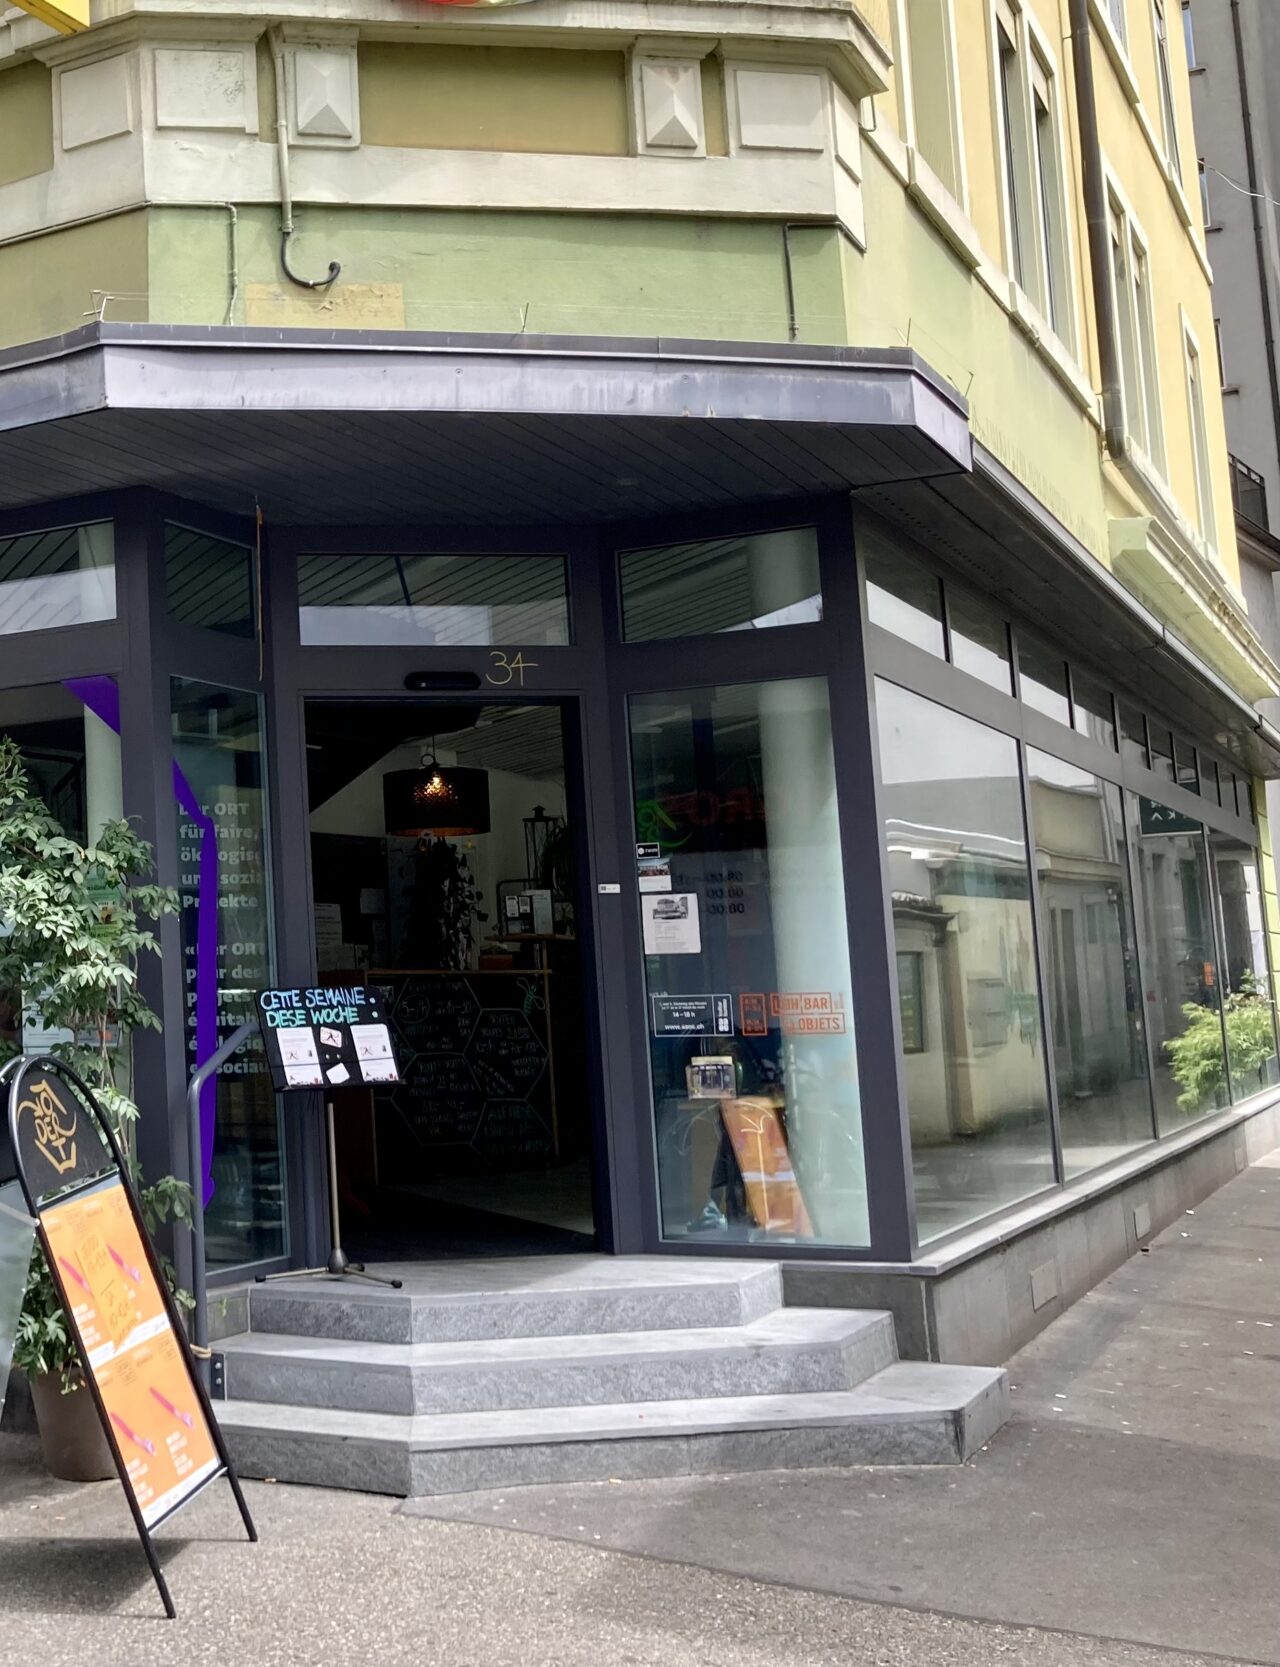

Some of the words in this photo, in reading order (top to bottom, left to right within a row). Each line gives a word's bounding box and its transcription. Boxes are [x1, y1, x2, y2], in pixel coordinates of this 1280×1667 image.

[485, 651, 539, 687] 34
[214, 802, 249, 816] ORT
[179, 823, 206, 839] für
[181, 874, 201, 885] un
[182, 893, 259, 910] Prekte
[187, 987, 251, 1007] pjets
[260, 989, 302, 1010] CETTE
[305, 987, 366, 1008] SEMAINE
[803, 997, 828, 1010] BAR
[266, 1008, 306, 1028] DIESE
[310, 1006, 359, 1024] WOCHE
[798, 1017, 840, 1031] OBJETS
[216, 1058, 269, 1074] sociau
